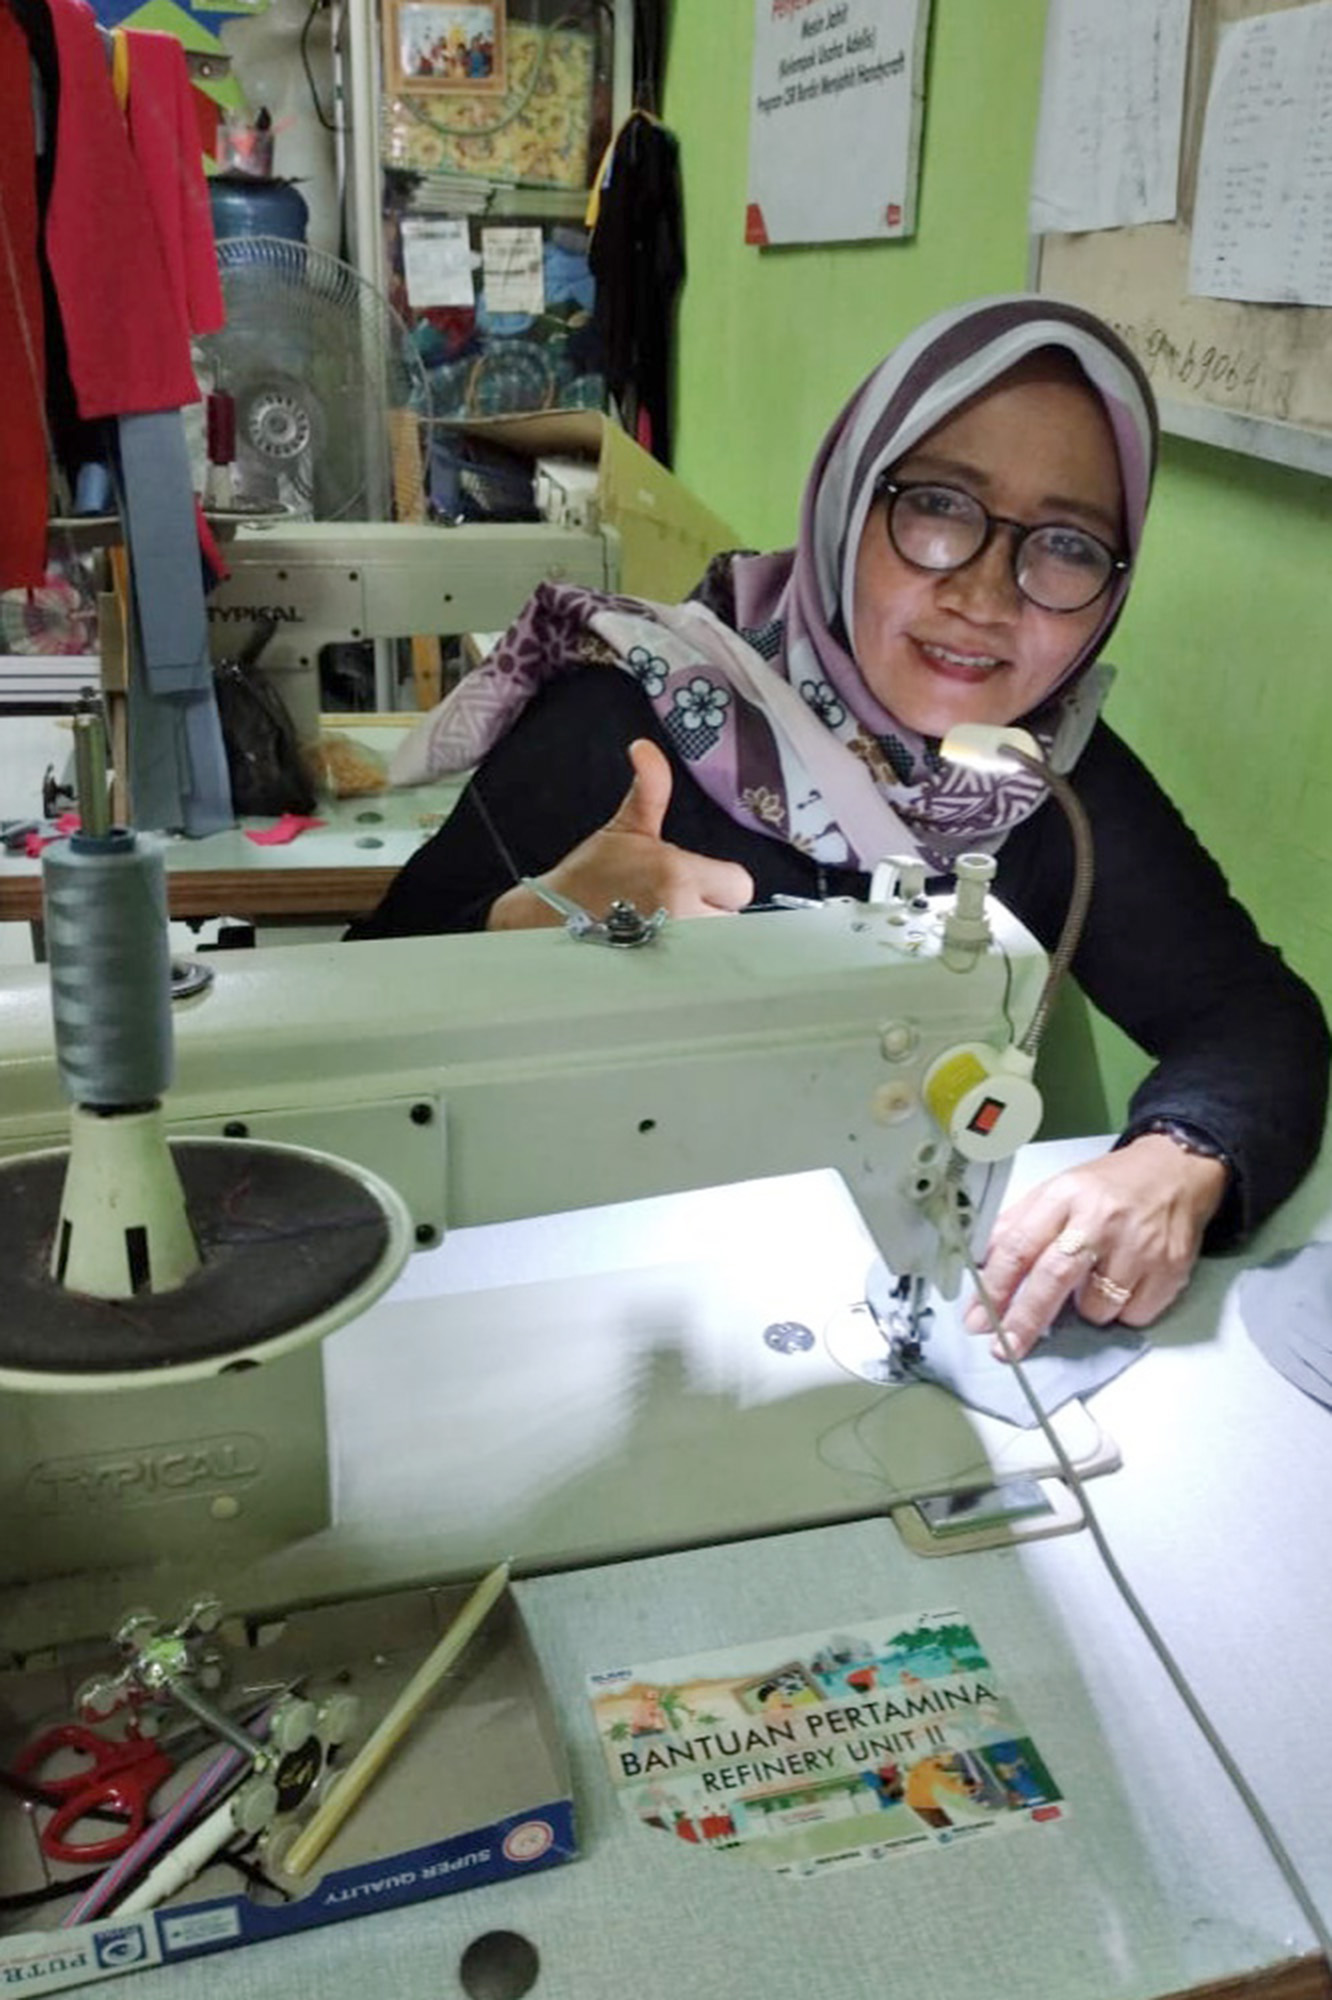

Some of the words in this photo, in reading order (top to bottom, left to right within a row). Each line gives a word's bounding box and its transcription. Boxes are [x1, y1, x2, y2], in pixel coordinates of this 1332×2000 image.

[620, 1719, 797, 1779] BANTUAN
[806, 1682, 1000, 1738] PERTAMINA
[702, 1746, 836, 1795] REFINERY
[846, 1730, 917, 1764] UNIT
[323, 1871, 416, 1906] QUALITY
[421, 1848, 492, 1881] SUPER
